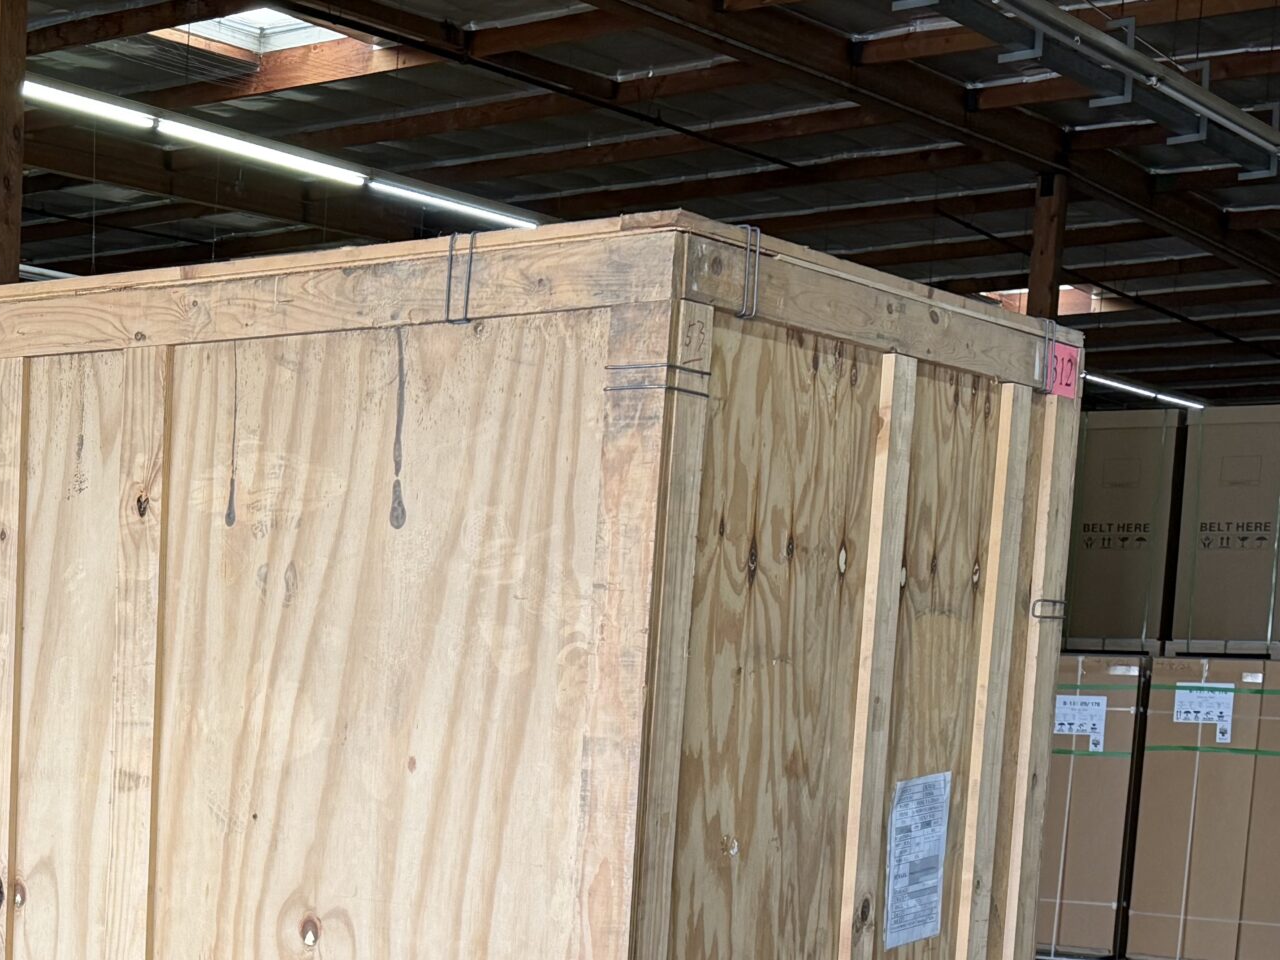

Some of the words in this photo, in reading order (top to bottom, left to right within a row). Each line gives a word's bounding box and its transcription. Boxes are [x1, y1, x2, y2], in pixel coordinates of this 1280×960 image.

[1053, 355, 1074, 387] 312
[1083, 522, 1114, 533] BELT
[1116, 522, 1150, 533] HERE
[1199, 522, 1233, 533] BELT
[1235, 521, 1271, 533] HERE
